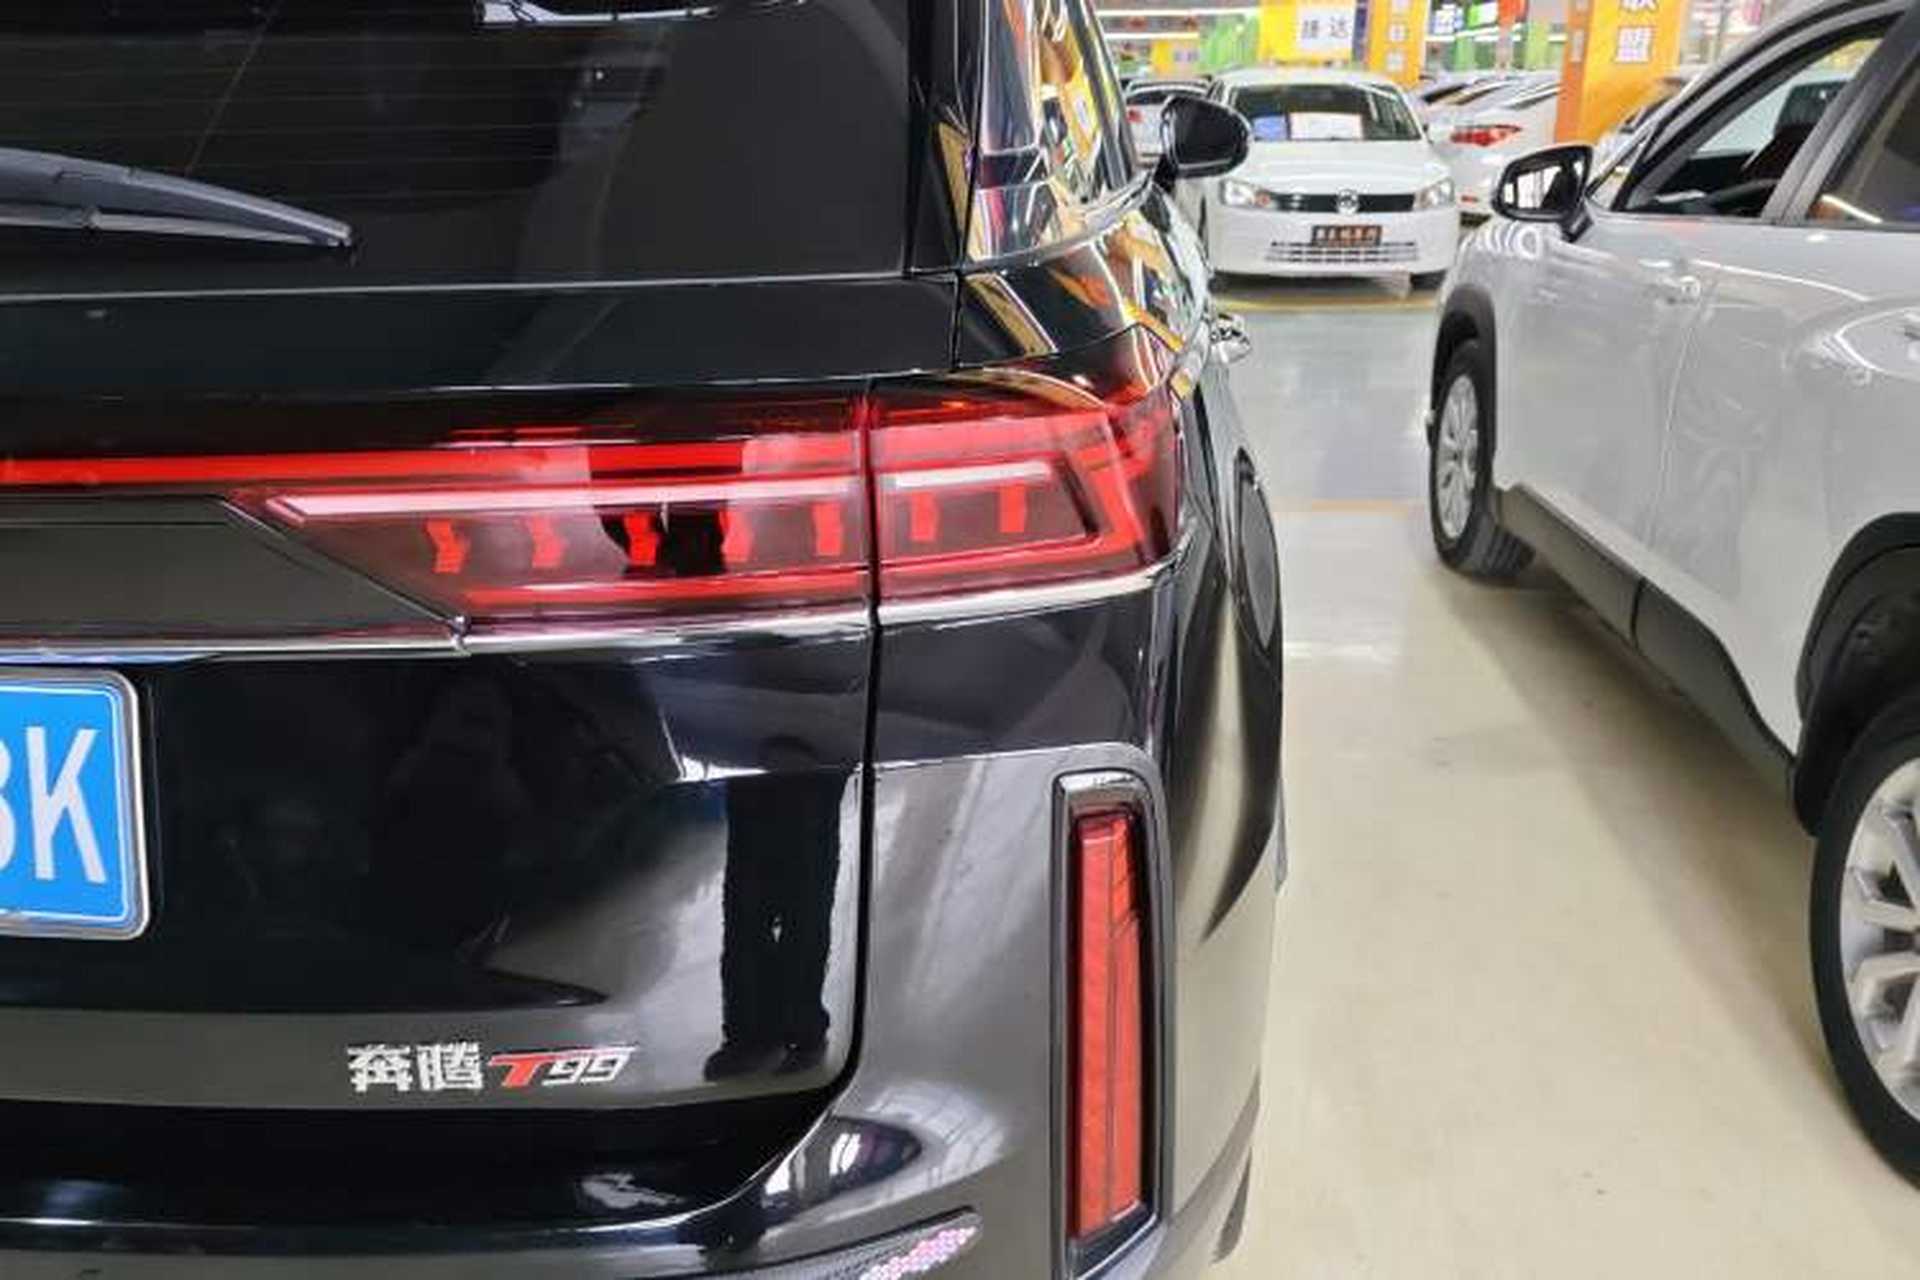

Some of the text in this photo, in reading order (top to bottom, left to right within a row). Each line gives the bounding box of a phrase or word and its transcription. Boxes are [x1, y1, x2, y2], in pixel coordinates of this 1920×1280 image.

[0, 725, 106, 883] K
[347, 1041, 636, 1092] 奔腾 T99
